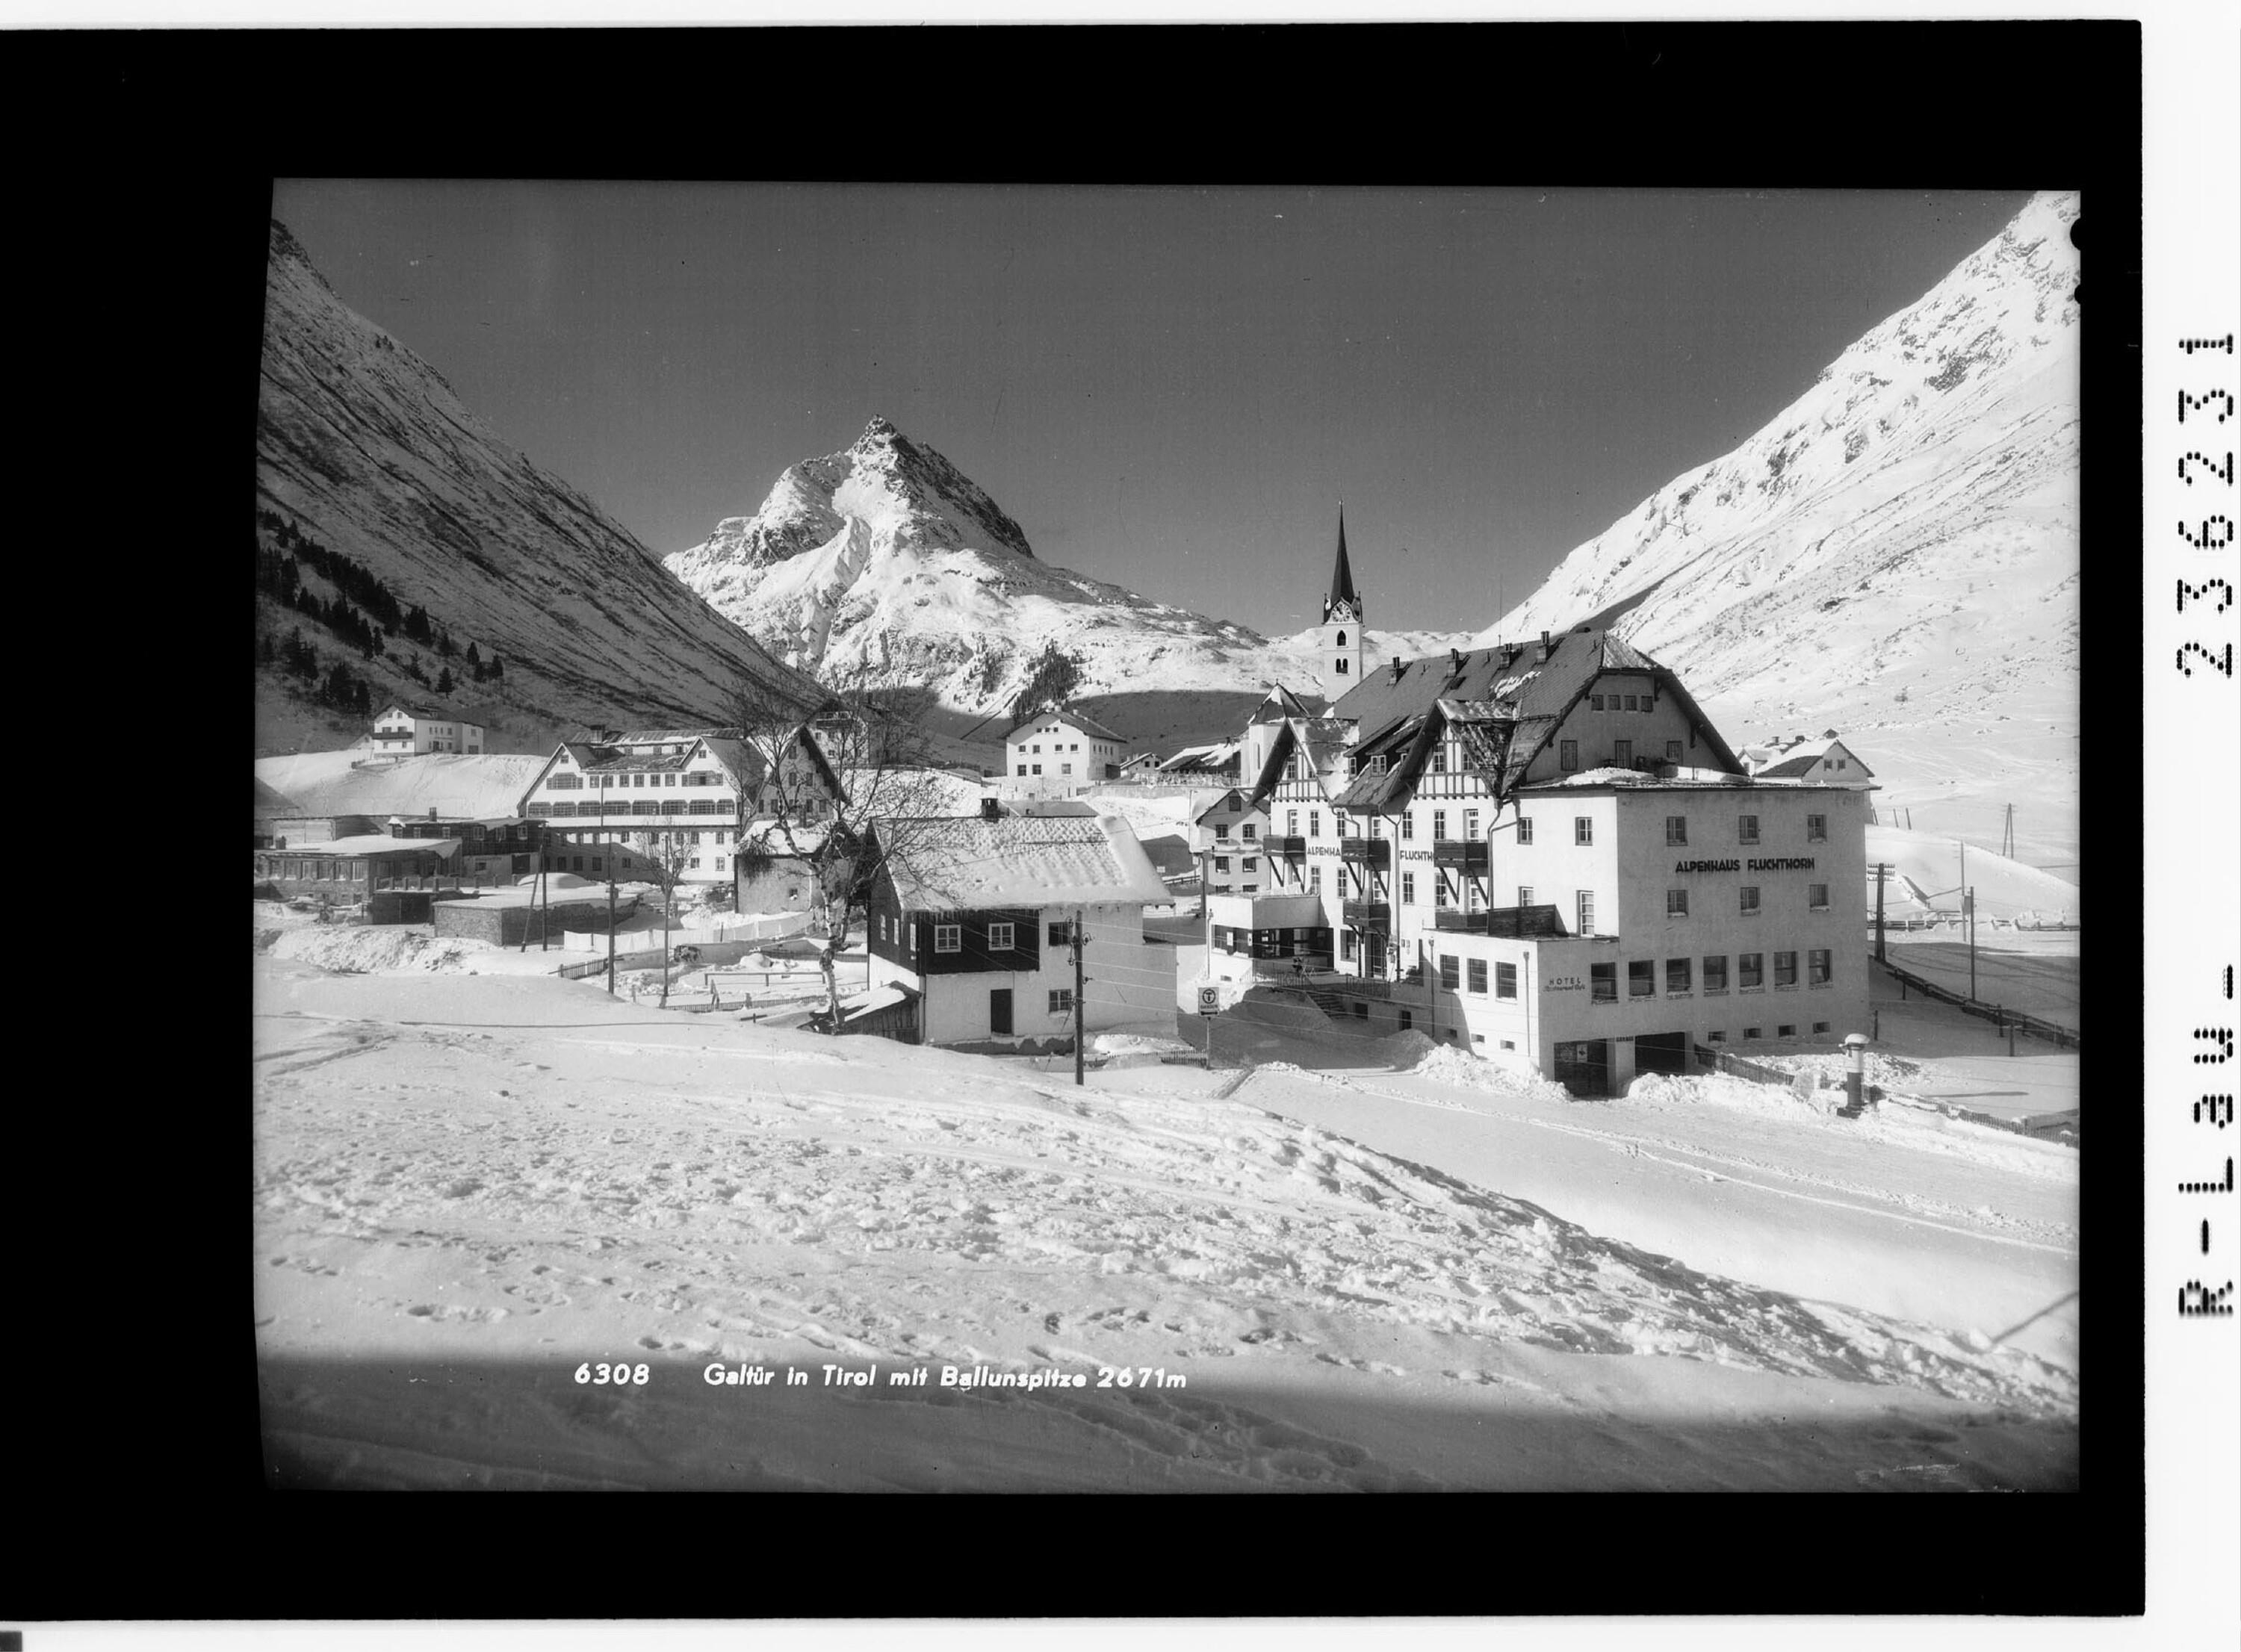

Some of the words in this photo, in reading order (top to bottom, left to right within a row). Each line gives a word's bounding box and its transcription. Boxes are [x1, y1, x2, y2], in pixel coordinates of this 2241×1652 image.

[2176, 333, 2234, 677] 236231
[1307, 846, 1341, 857] ALPENHA
[1399, 850, 1433, 861] FLUCHTH
[1676, 859, 1741, 873] ALPENHAUS
[1747, 857, 1816, 872] FLUCHTHORN
[1549, 977, 1581, 986] HOTEL
